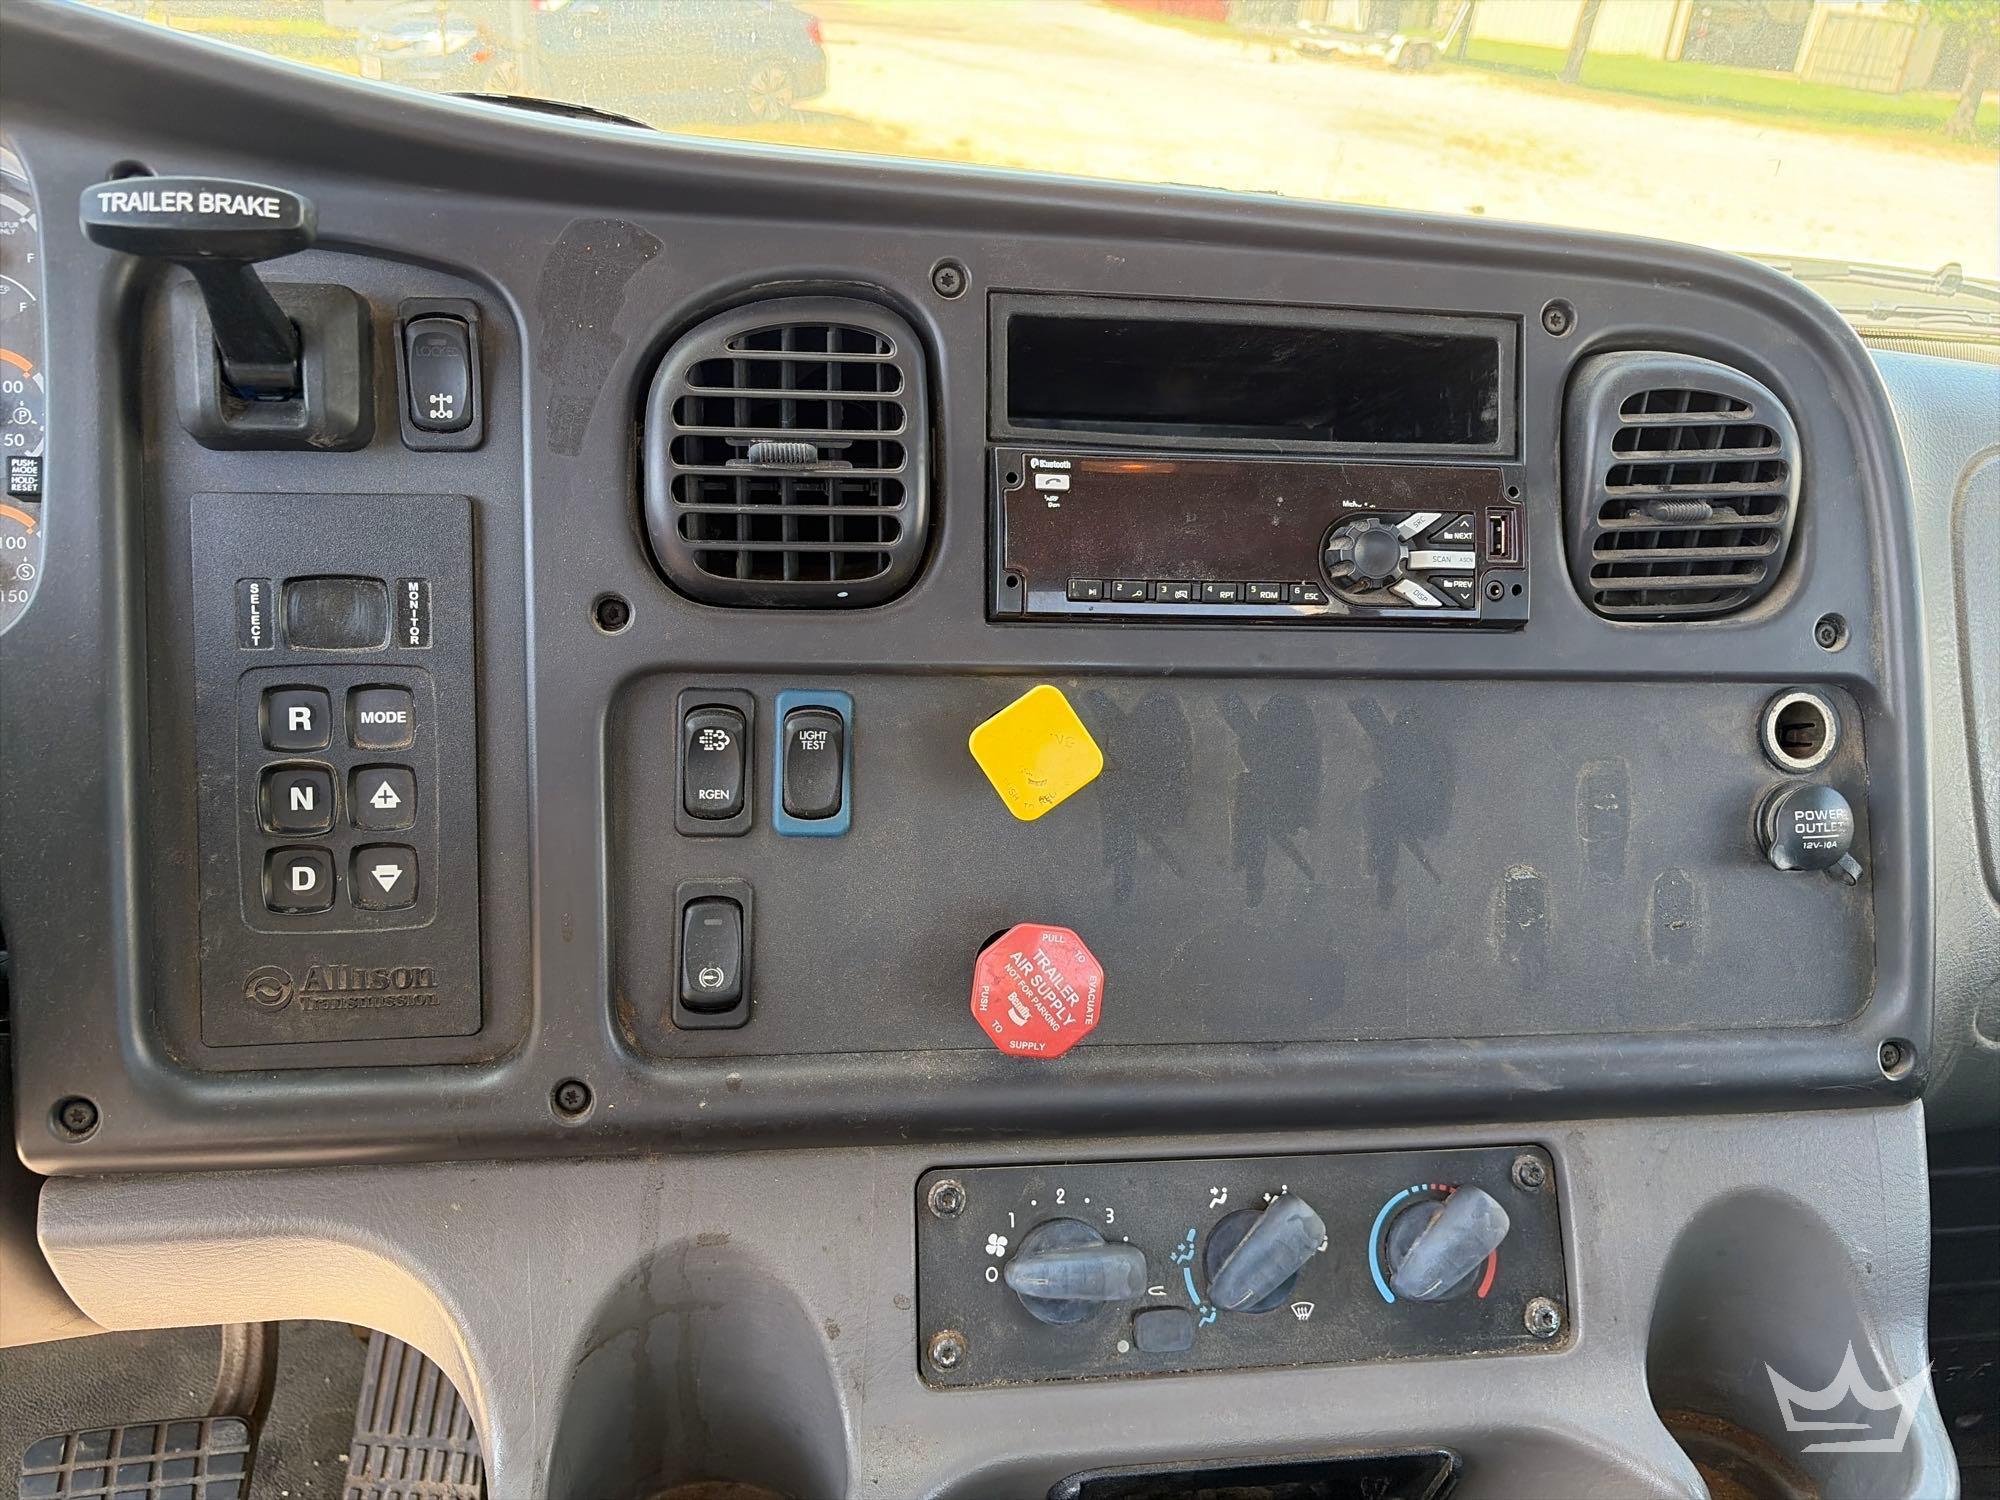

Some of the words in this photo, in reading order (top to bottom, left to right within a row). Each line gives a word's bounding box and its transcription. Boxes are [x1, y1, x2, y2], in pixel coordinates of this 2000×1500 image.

[97, 191, 194, 213] TRAILER
[198, 192, 281, 219] BRAKE
[27, 253, 35, 263] F
[20, 302, 27, 312] F
[11, 466, 38, 474] MODE
[11, 476, 38, 484] HOLD-
[11, 484, 38, 492] RESET
[1454, 532, 1473, 540] NEXT
[1432, 555, 1452, 563] SCAN
[1453, 580, 1473, 588] PREV
[1413, 589, 1429, 602] DISP
[250, 583, 261, 646] SELECT
[408, 582, 420, 645] MONITOR
[288, 706, 312, 731] R
[360, 711, 407, 724] MODE
[799, 730, 828, 741] LIGHT
[801, 740, 826, 750] TEST
[290, 786, 314, 811] N
[698, 790, 730, 800] RGEN
[1794, 809, 1849, 821] POWER
[1794, 821, 1846, 834] OUTLET
[1803, 841, 1838, 850] 12V-10A
[292, 866, 316, 891] D
[300, 965, 438, 992] Allison
[1032, 948, 1080, 1008] TRAILER
[1041, 933, 1065, 944] PULL
[1074, 949, 1086, 963] TO
[1084, 975, 1097, 1025] EVACUATE
[1010, 951, 1034, 977] AIR
[1030, 974, 1077, 1026] SUPPLY
[1004, 963, 1020, 984] NOT
[1018, 978, 1034, 998] FOR
[1031, 996, 1060, 1032] PARKING
[980, 985, 990, 1011] PUSH
[991, 1020, 1003, 1034] TO
[1009, 1040, 1046, 1051] SUPPLY
[1056, 1188, 1066, 1205] 2
[1008, 1212, 1015, 1228] 1
[1105, 1207, 1115, 1224] 3
[985, 1266, 999, 1283] 0
